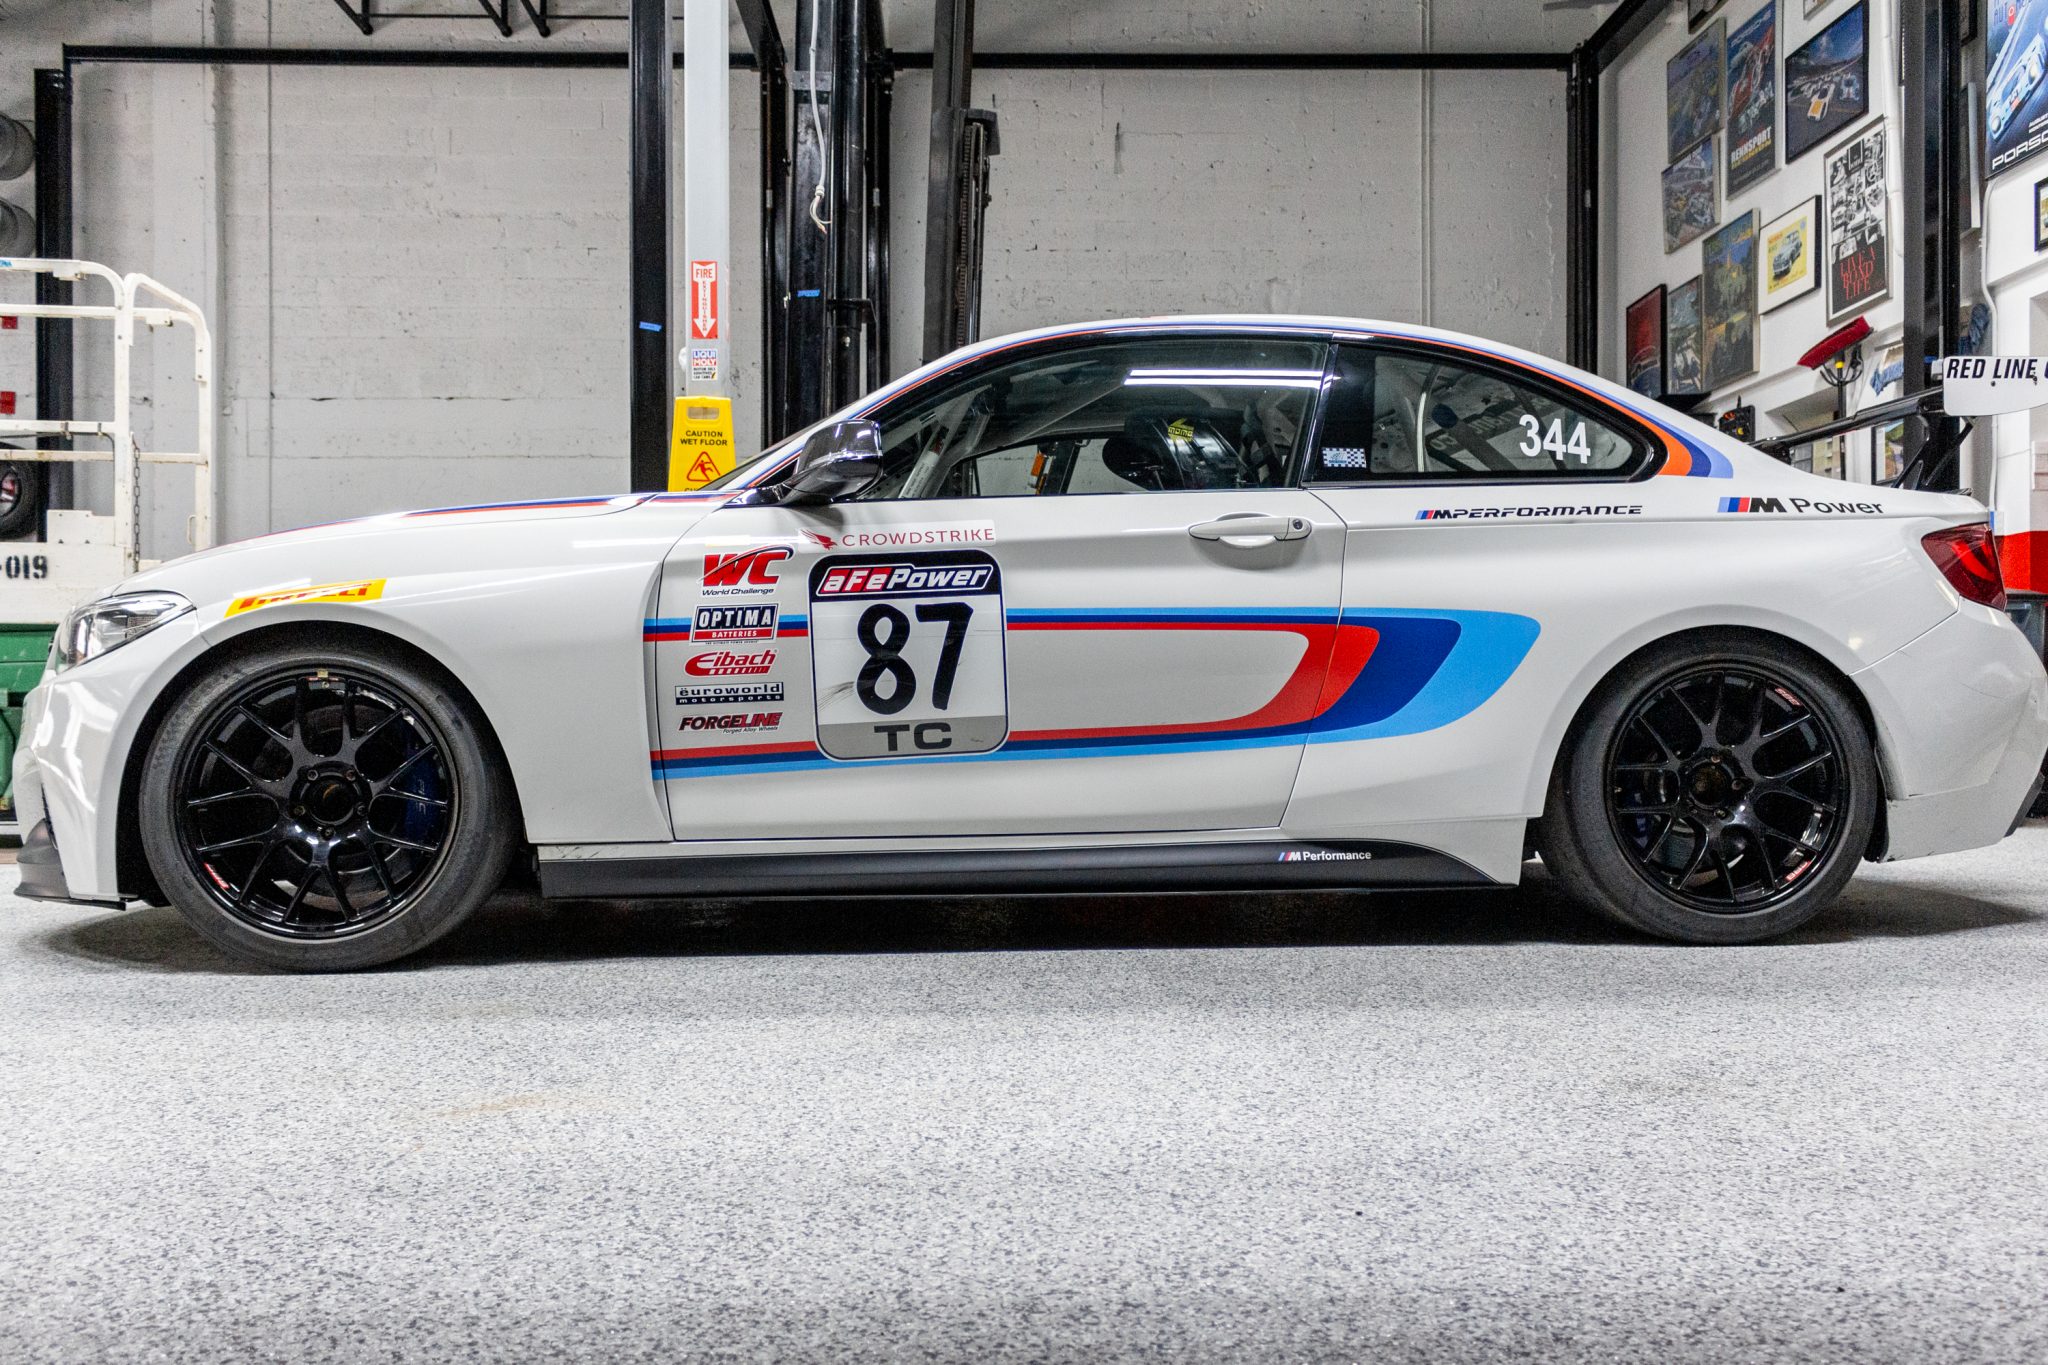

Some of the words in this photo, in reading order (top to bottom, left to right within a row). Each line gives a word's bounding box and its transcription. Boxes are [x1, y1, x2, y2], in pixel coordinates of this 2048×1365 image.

[696, 269, 712, 278] FIRE
[693, 358, 716, 366] MOLY
[1946, 359, 1986, 378] RED
[1993, 359, 2038, 378] LINE
[1519, 414, 1591, 464] 344
[1789, 498, 1883, 514] Power
[842, 528, 995, 547] CROWDSTRIKE
[703, 552, 788, 587] WC
[698, 609, 772, 628] OPTIMA
[712, 630, 757, 638] BATTERIES
[685, 650, 777, 676] Eibach
[857, 602, 974, 715] 87
[680, 695, 780, 703] motorsports
[679, 712, 783, 730] FORGELINE
[874, 722, 952, 751] TC
[1303, 851, 1372, 860] Performance
